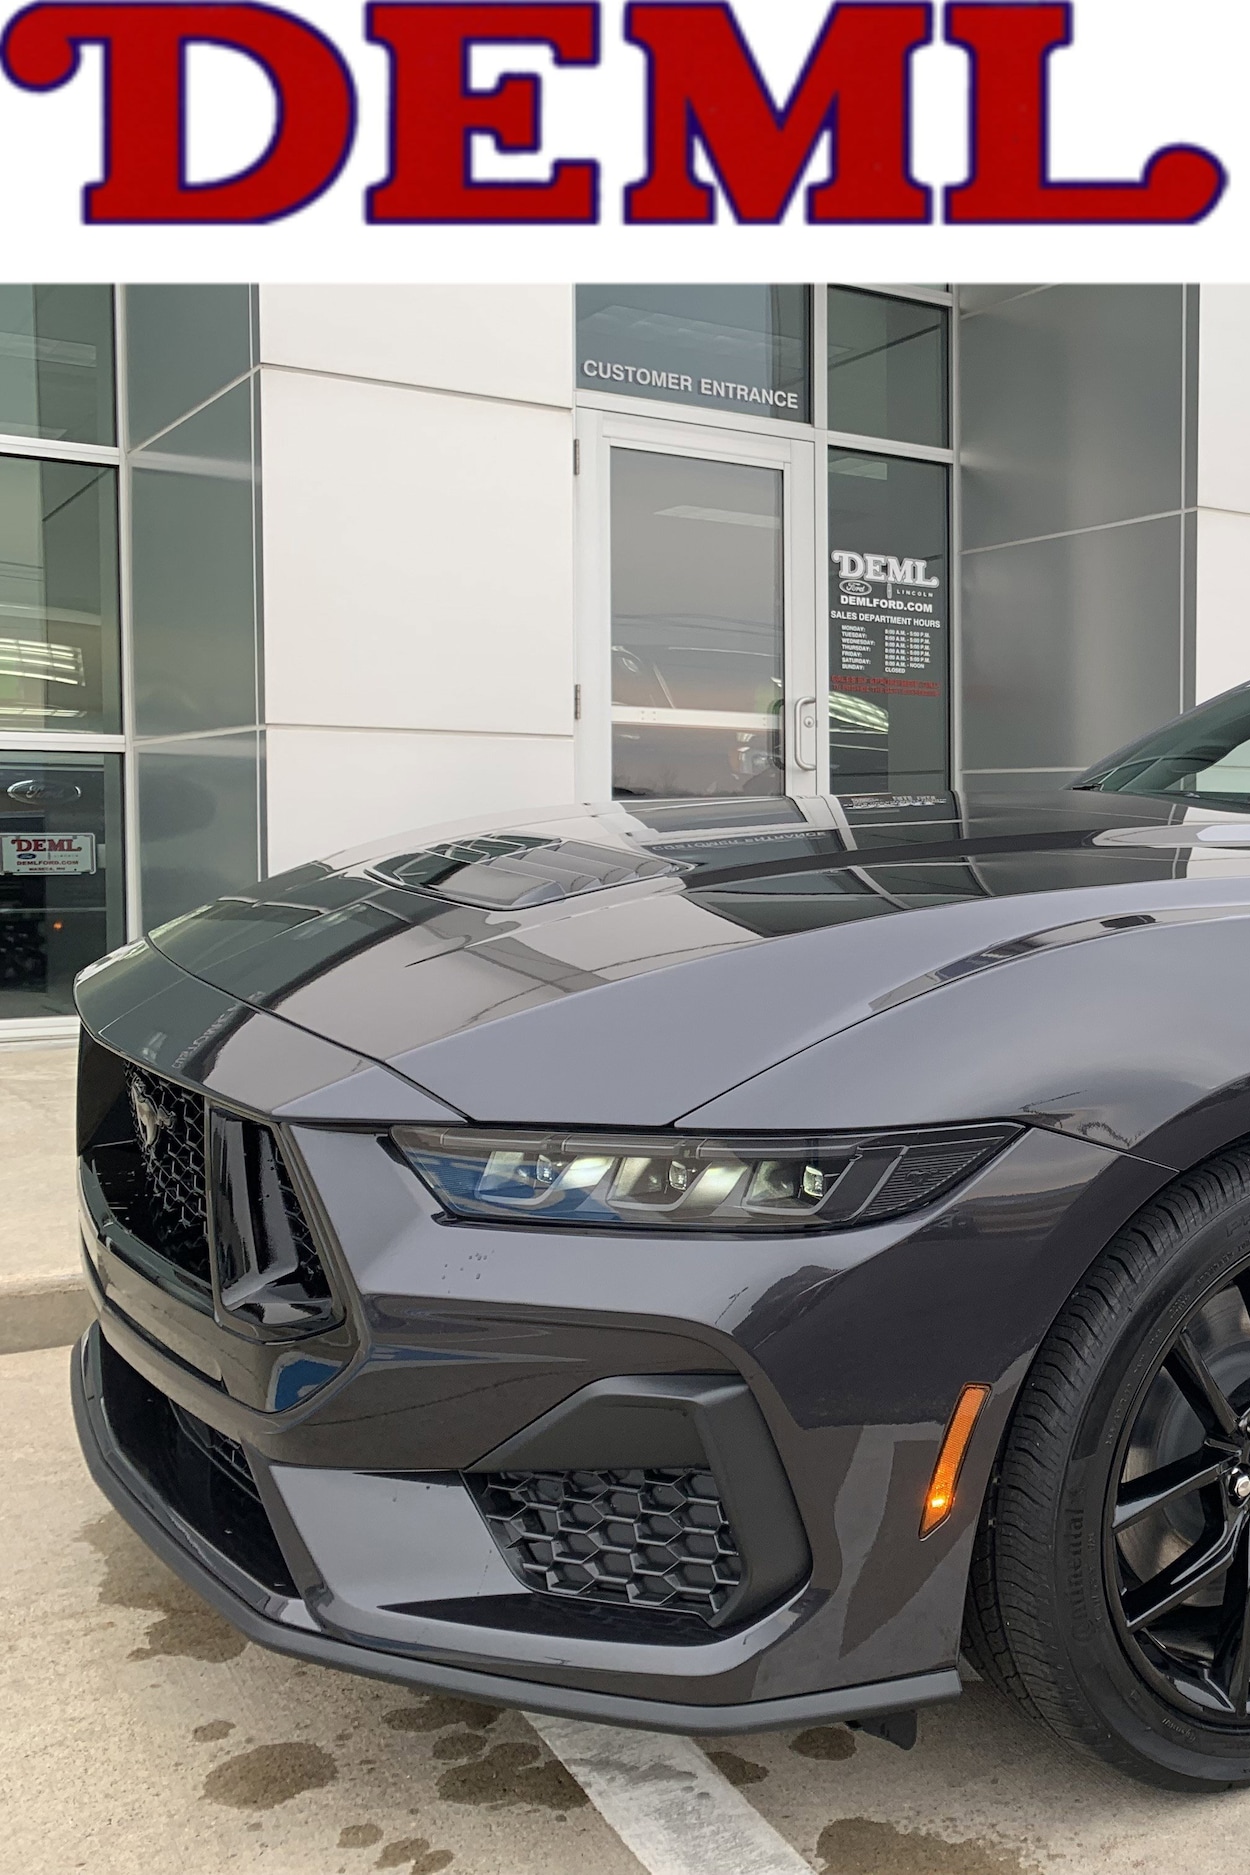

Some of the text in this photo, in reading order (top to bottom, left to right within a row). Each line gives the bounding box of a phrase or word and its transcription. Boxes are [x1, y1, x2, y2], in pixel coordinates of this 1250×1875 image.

[583, 360, 798, 409] CUSTOMER ENTRANCE
[831, 550, 939, 588] DEML
[896, 588, 933, 597] LINCOLN
[840, 595, 933, 613] DEMLFORD.COM
[831, 610, 941, 628] SALES DEPARTMENT HOURS
[11, 838, 82, 852] DEML
